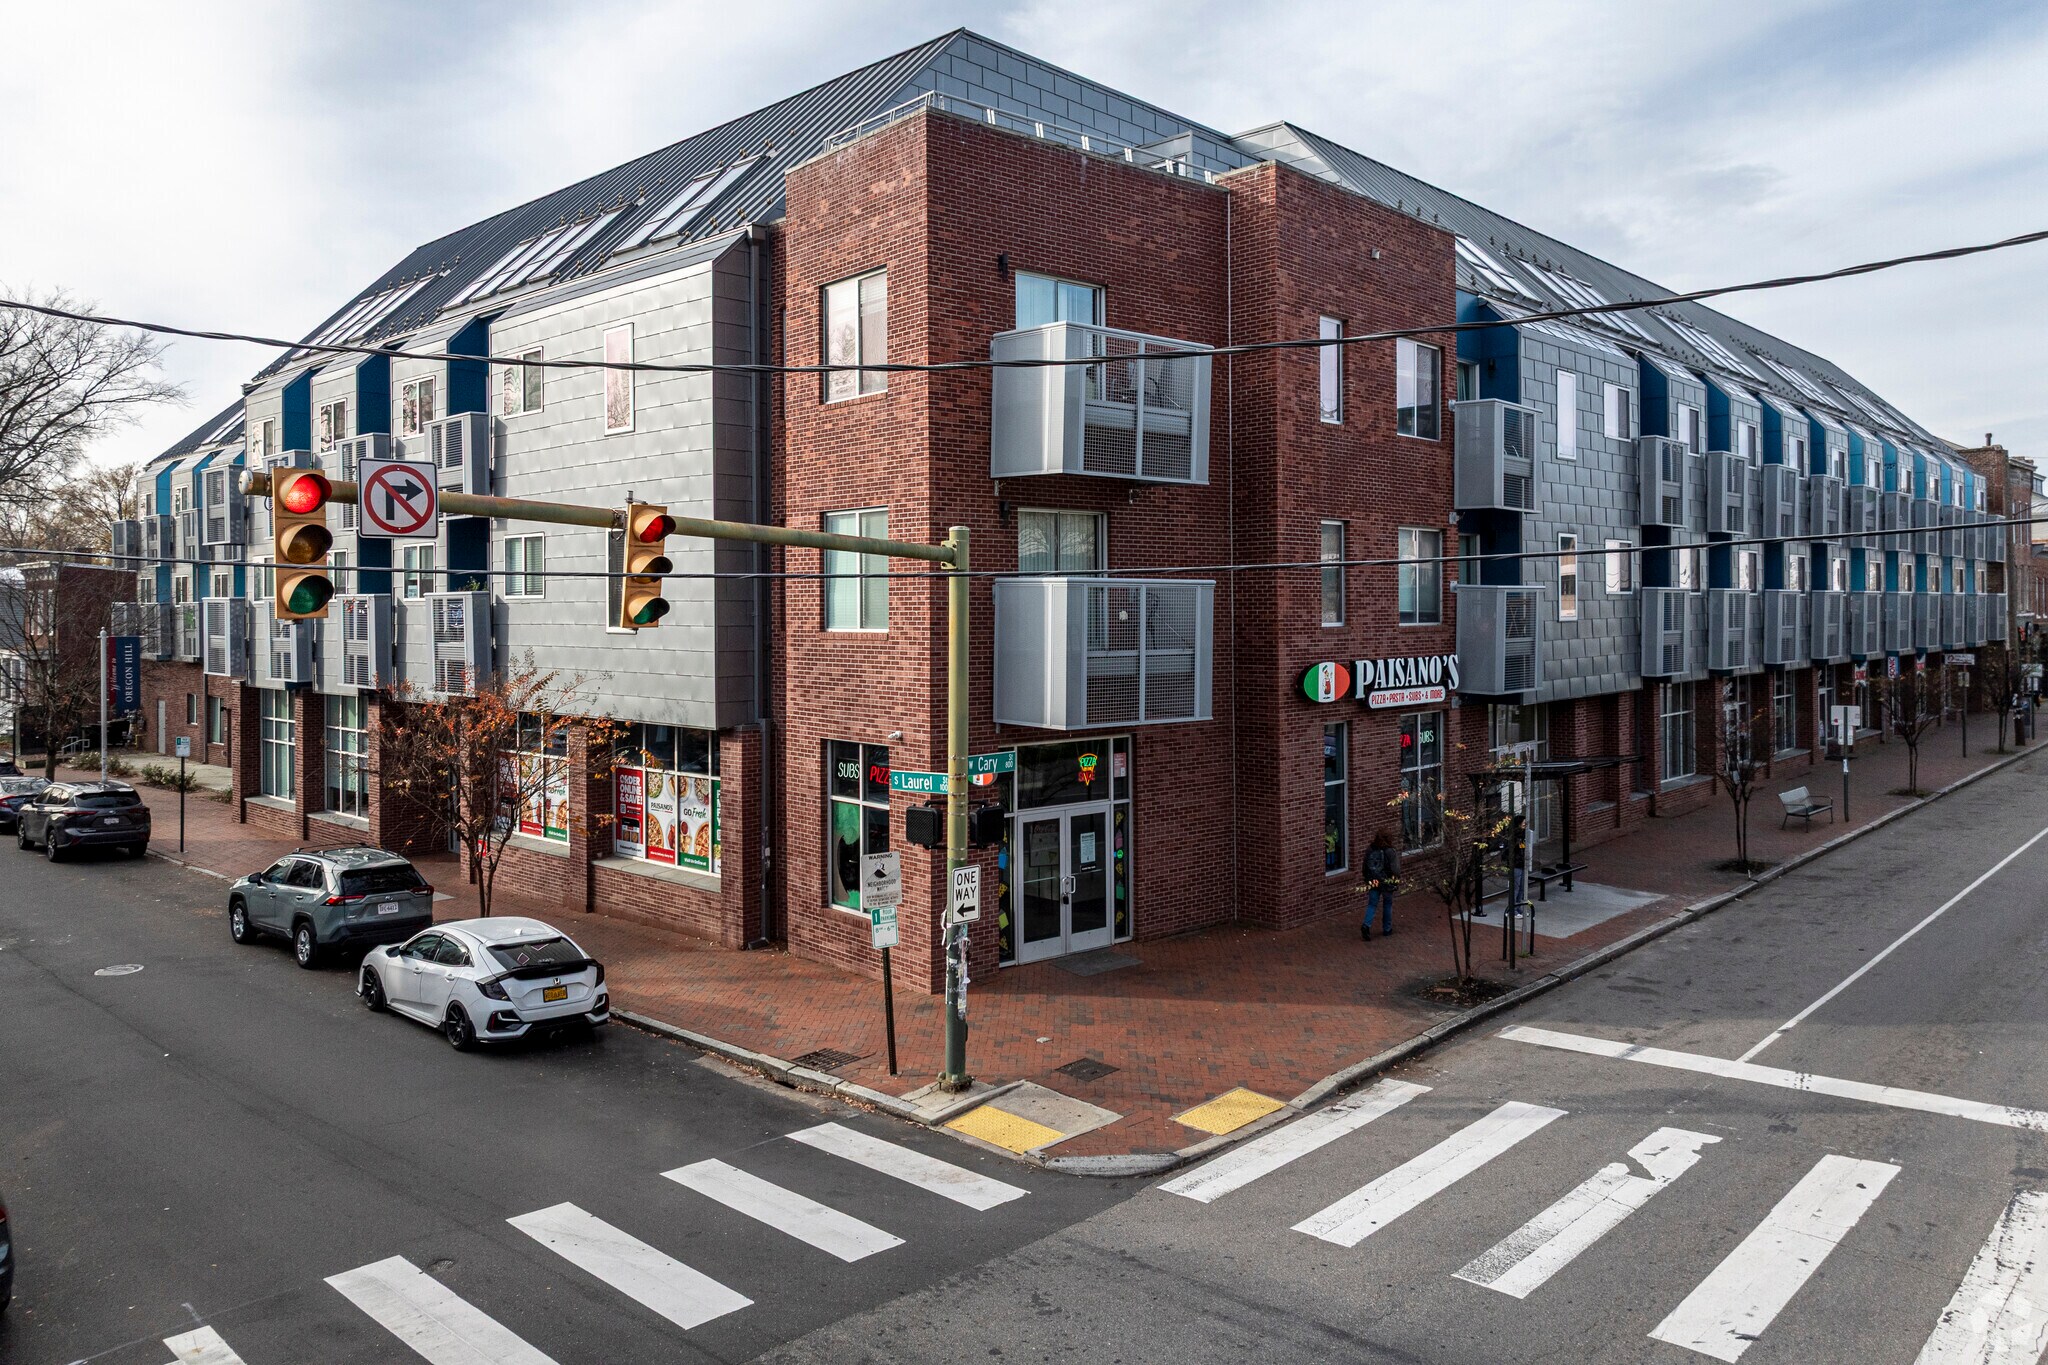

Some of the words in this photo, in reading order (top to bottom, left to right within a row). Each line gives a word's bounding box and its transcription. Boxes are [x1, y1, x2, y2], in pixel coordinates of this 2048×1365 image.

[125, 644, 133, 663] HILL
[125, 667, 133, 703] OREGON
[1355, 654, 1460, 700] PAISANO'S
[1371, 694, 1387, 705] PIZZA
[1389, 692, 1405, 704] PASTA
[1408, 691, 1422, 702] SUBS
[1429, 689, 1443, 699] MORE
[968, 760, 974, 770] W
[978, 756, 998, 773] Cary
[1005, 760, 1013, 769] 800
[1008, 753, 1013, 761] St
[1079, 756, 1097, 768] PIZZA
[838, 762, 860, 779] SUBS
[869, 765, 889, 785] PIZZ
[620, 775, 641, 786] ORDER
[894, 775, 899, 785] S
[902, 773, 933, 790] Laurel
[620, 784, 642, 796] ONLINE
[683, 807, 692, 816] GO
[867, 878, 897, 888] NEIGHBORHOOD
[956, 870, 977, 886] ONE
[955, 885, 977, 901] WAY
[874, 912, 878, 923] 1
